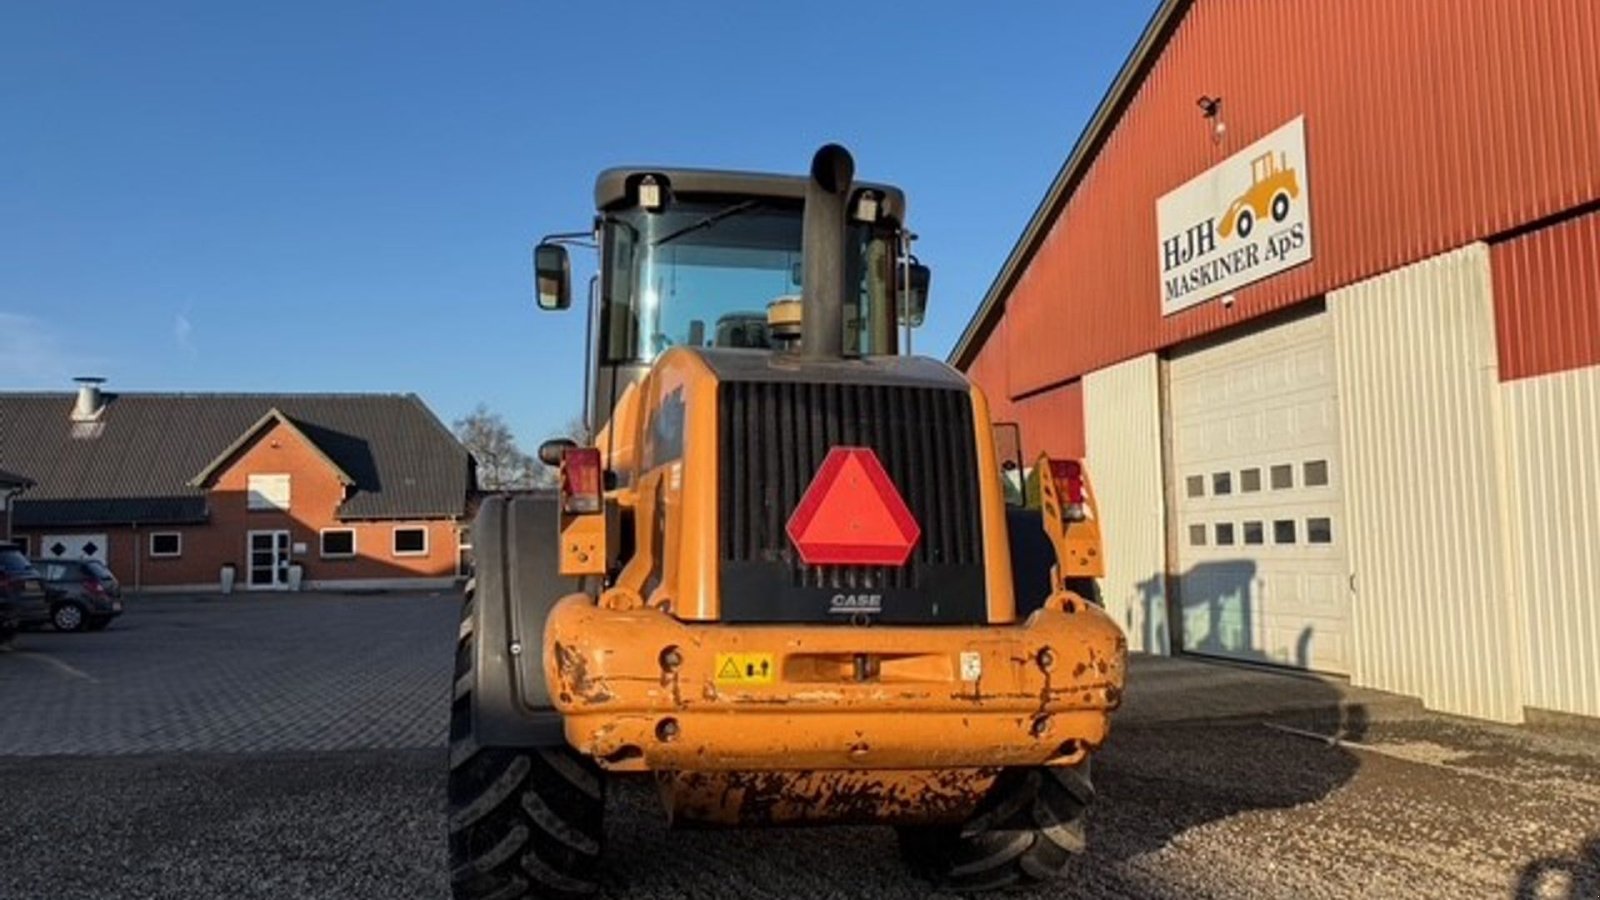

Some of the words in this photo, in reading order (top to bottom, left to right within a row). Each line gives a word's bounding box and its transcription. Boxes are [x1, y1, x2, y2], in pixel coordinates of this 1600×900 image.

[1163, 218, 1216, 272] HJH
[1165, 243, 1260, 301] MASKINER
[1264, 222, 1305, 261] ApS
[831, 594, 881, 606] CASE
